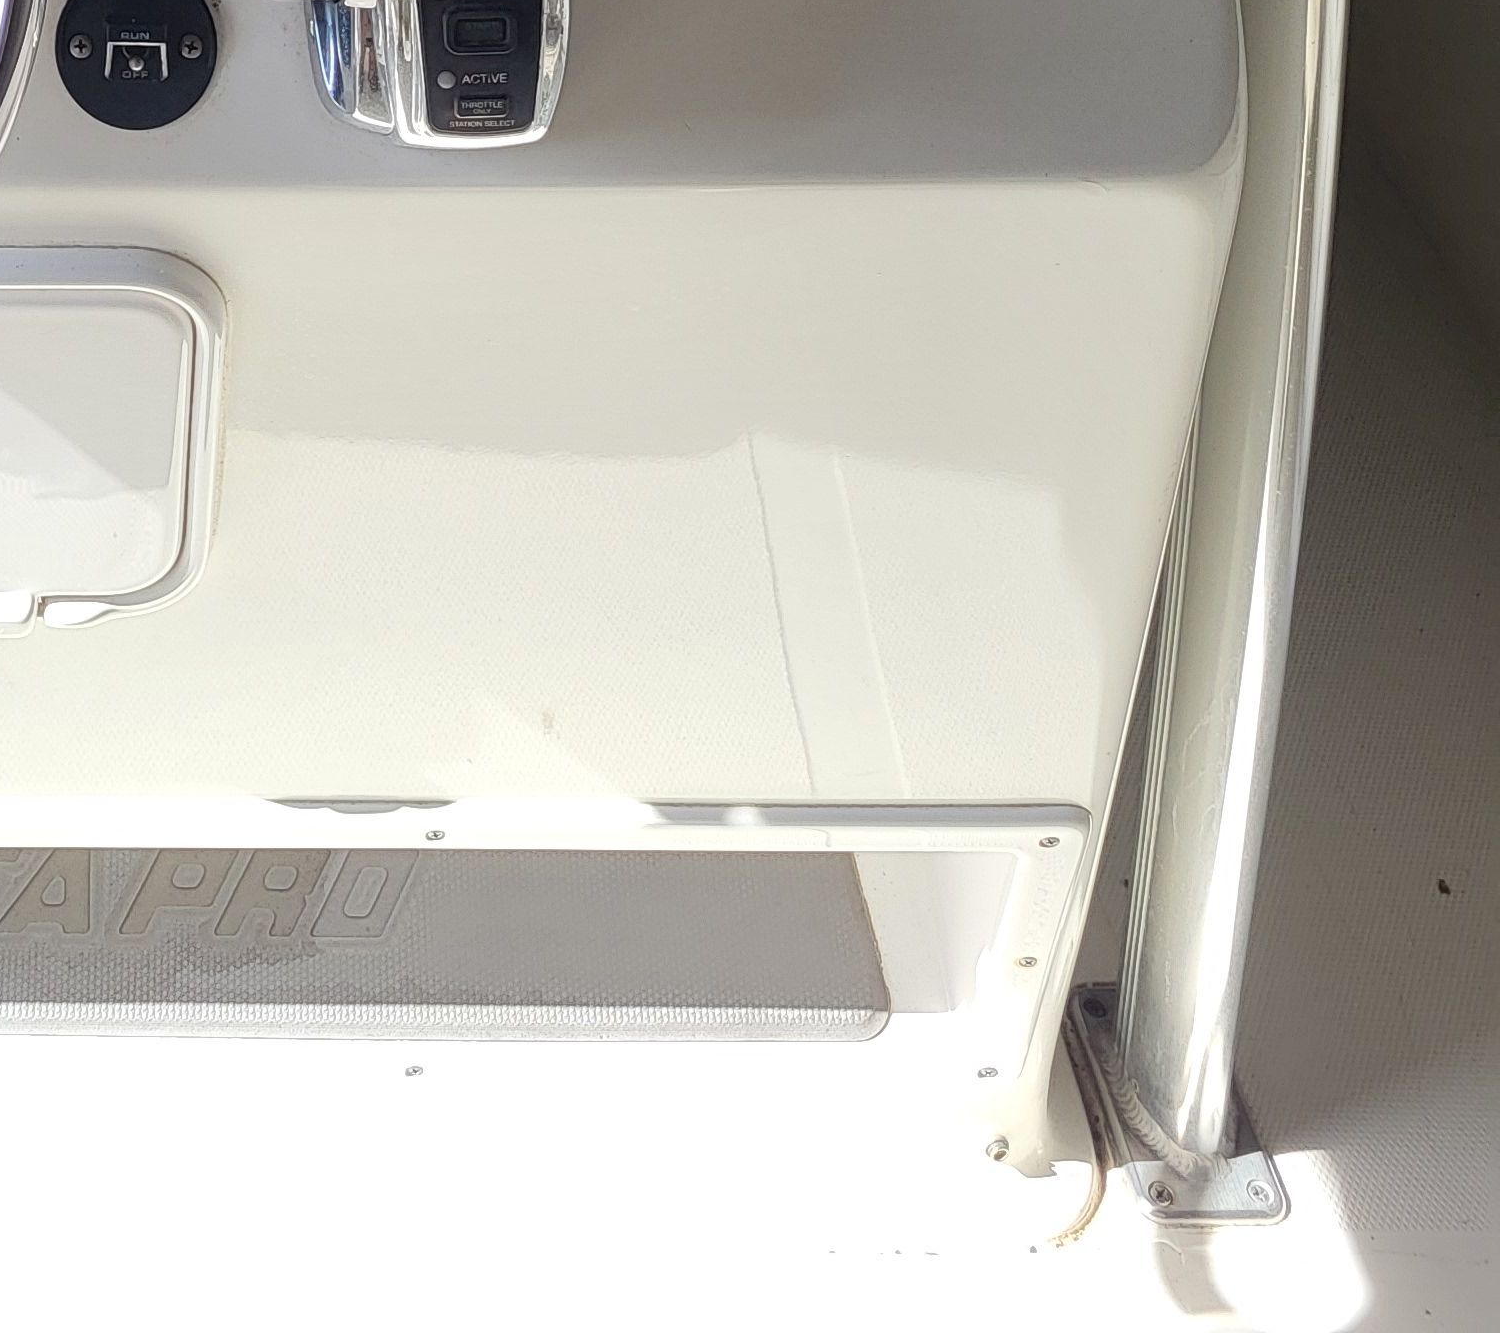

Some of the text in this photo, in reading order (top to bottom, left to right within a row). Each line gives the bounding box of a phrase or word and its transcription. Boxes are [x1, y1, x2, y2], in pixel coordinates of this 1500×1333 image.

[120, 32, 150, 40] RUN
[122, 70, 149, 78] OFF
[461, 73, 508, 84] ACTIVE
[461, 101, 503, 109] THROTTLE
[119, 849, 420, 937] PRO
